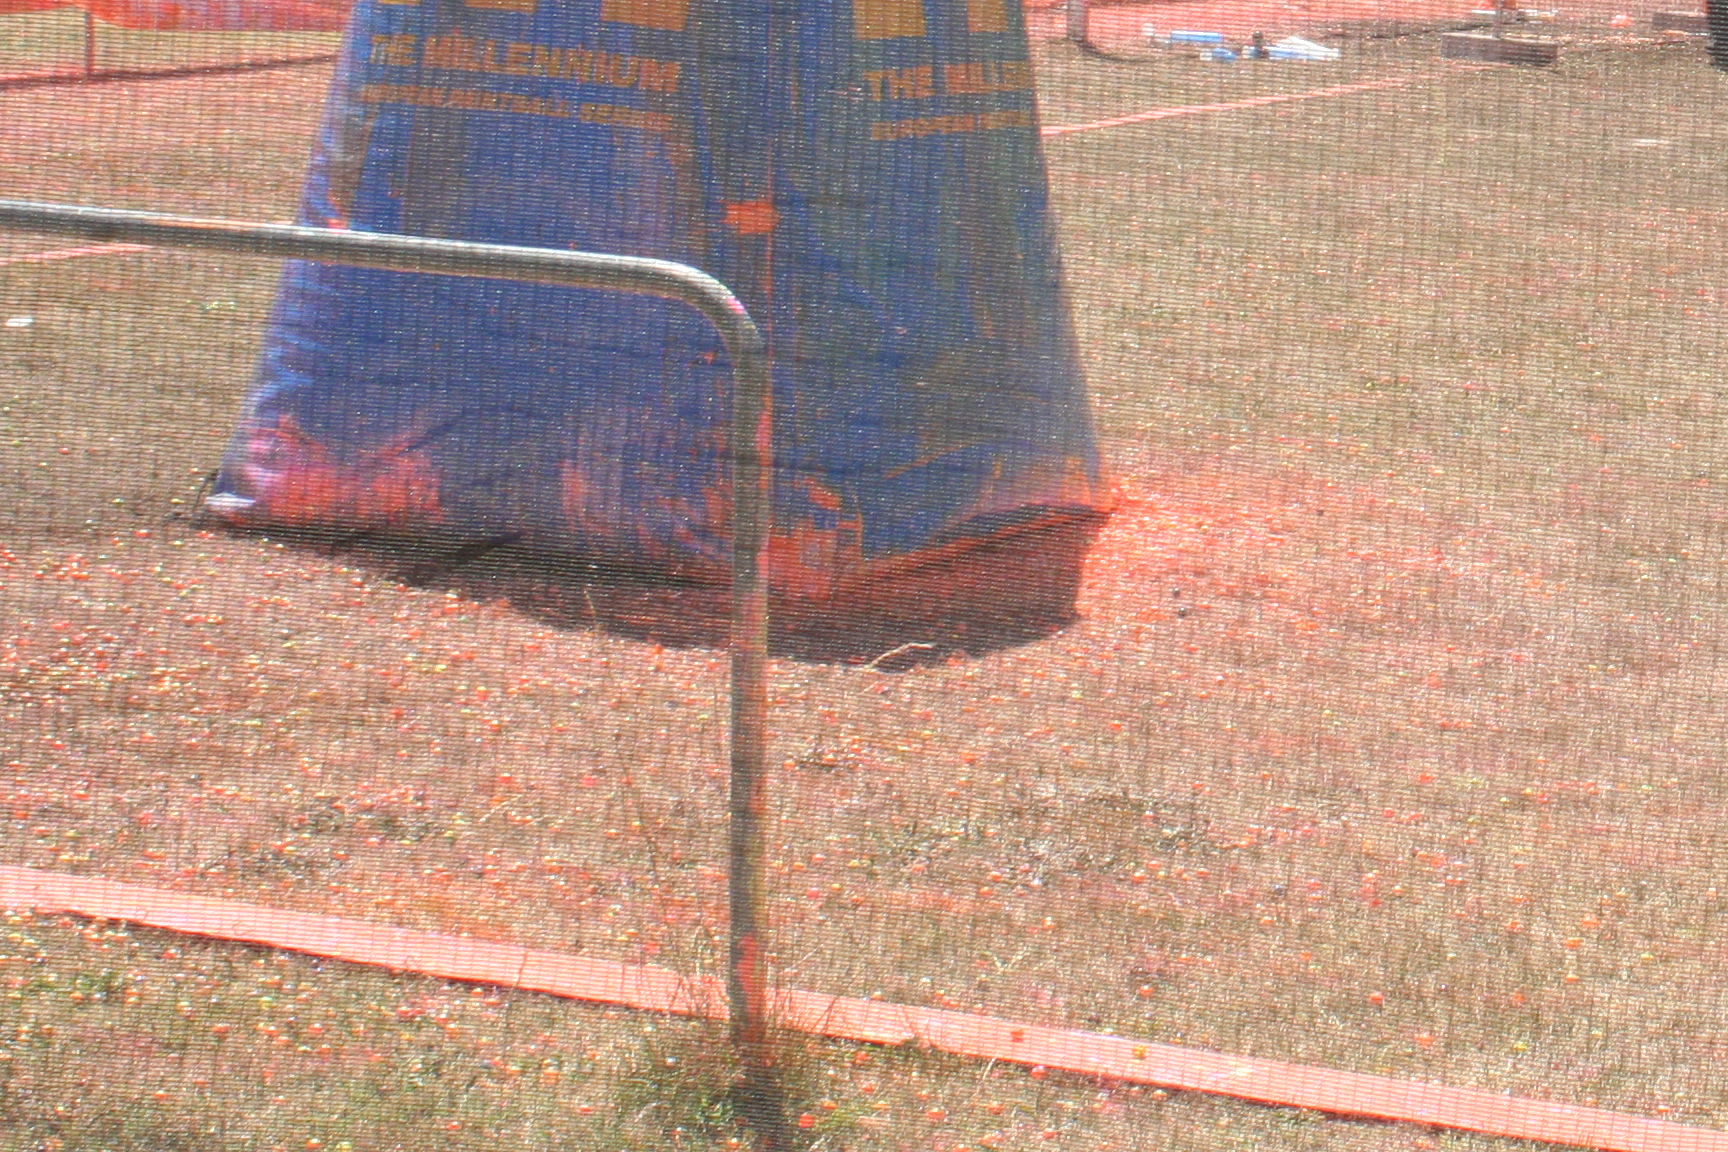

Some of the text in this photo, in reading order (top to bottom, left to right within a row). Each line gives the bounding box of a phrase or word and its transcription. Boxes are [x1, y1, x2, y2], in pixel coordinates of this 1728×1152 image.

[370, 34, 682, 94] THE MILLENNIUM
[863, 66, 936, 102] THE
[449, 88, 571, 119] PAINTBALL
